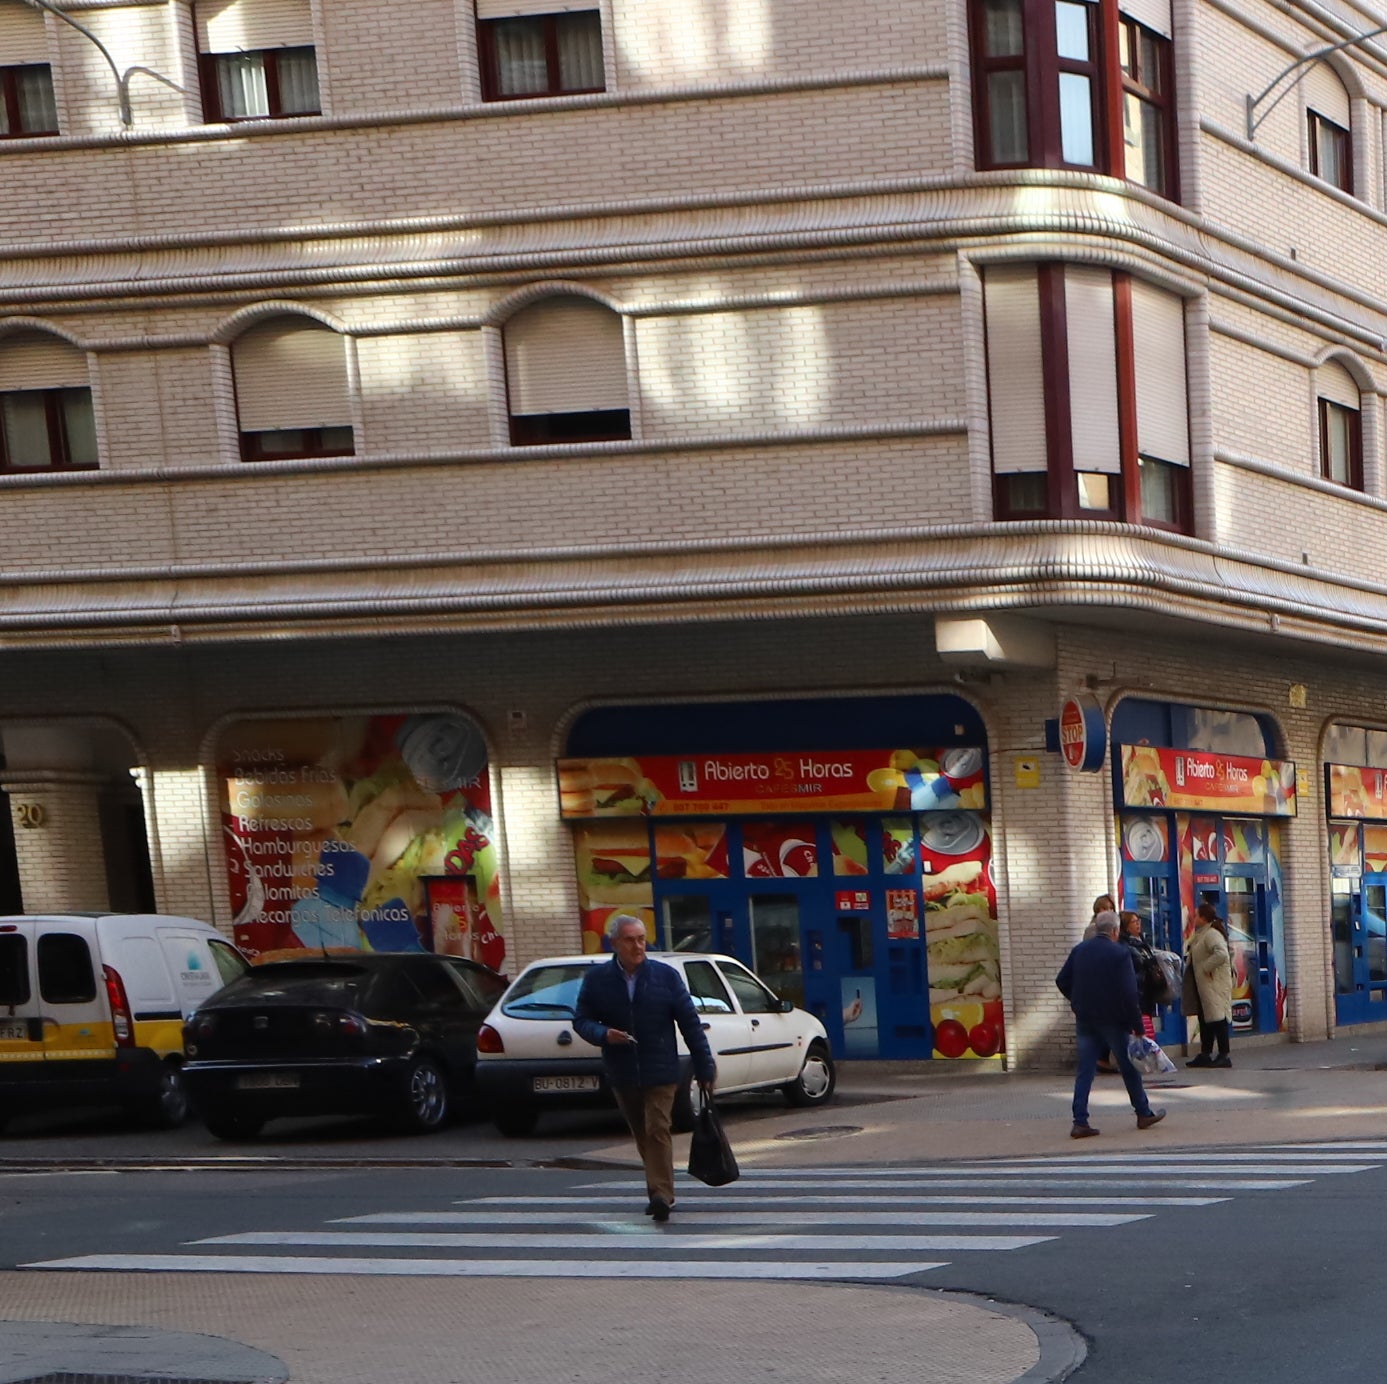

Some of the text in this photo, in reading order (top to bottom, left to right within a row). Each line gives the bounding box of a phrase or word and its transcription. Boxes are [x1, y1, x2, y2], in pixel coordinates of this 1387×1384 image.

[234, 766, 297, 785] Bebidas
[704, 757, 853, 782] Abierto 25 Horas
[1186, 757, 1215, 779] Abierto
[1226, 764, 1248, 782] Horas
[236, 791, 313, 808] Golosinas
[16, 803, 43, 827] 20
[238, 815, 313, 832] Refrescos
[241, 836, 357, 858] Hamburguesas
[243, 859, 335, 879] Sandwiches
